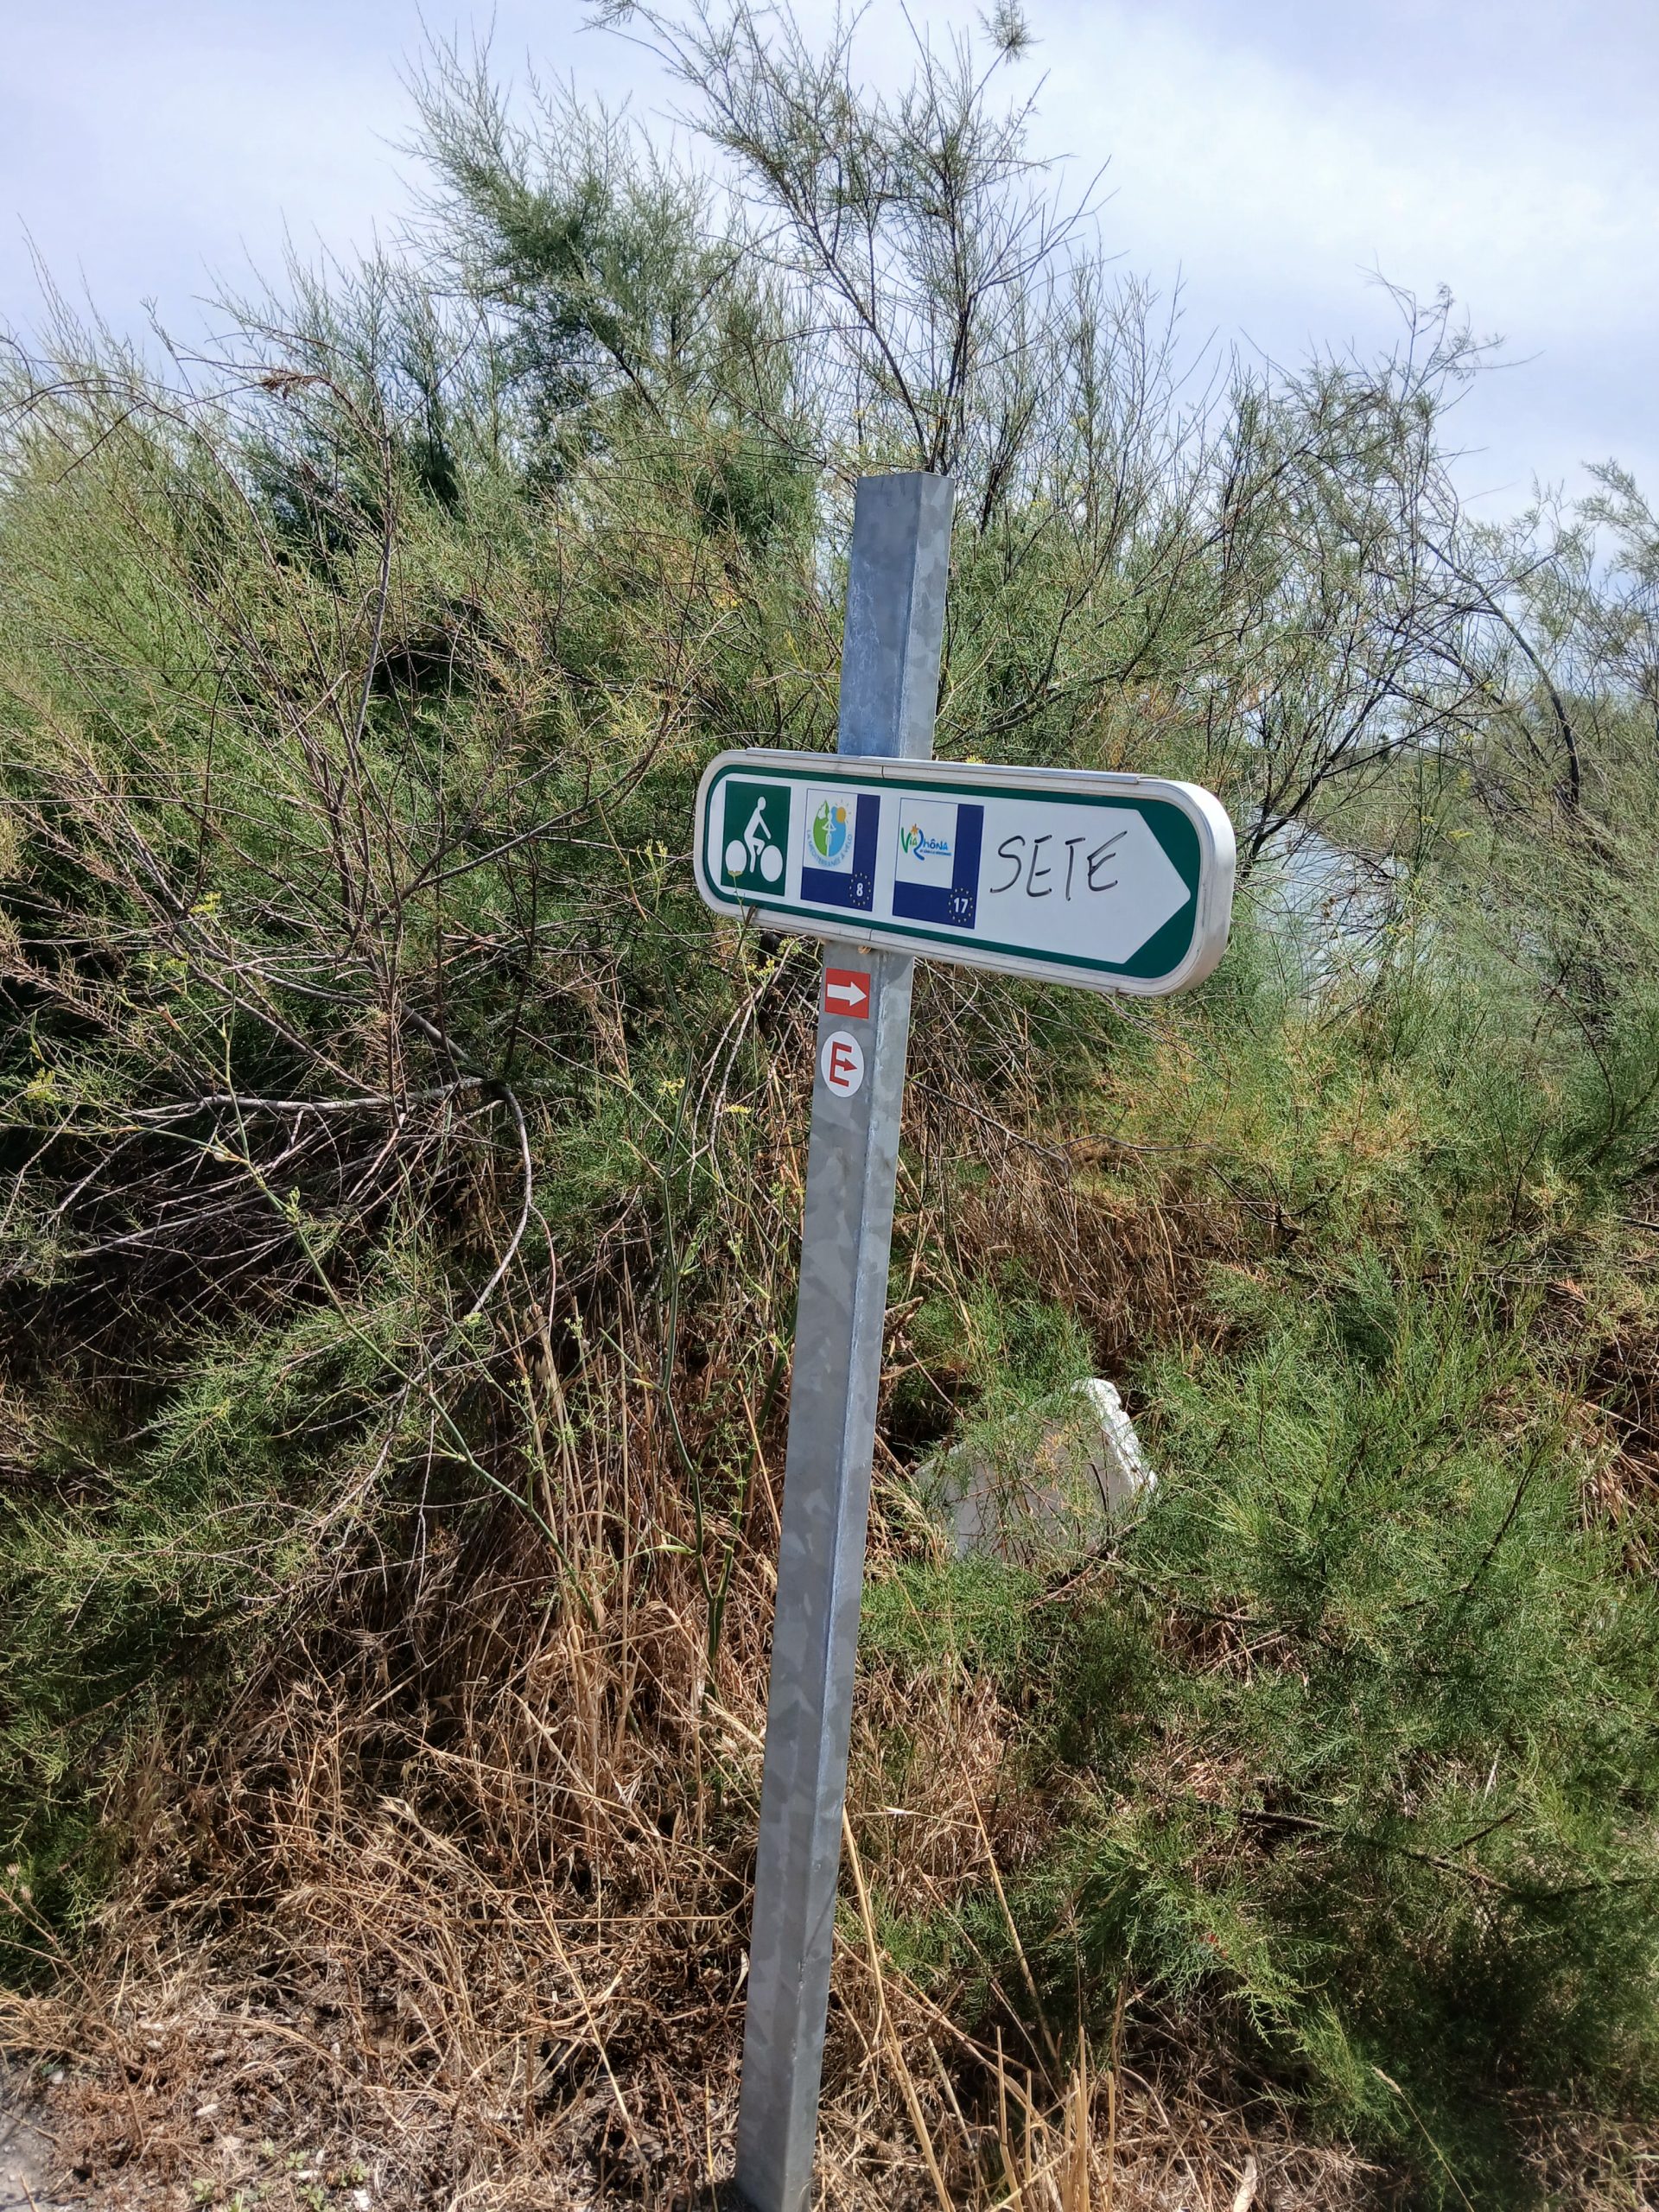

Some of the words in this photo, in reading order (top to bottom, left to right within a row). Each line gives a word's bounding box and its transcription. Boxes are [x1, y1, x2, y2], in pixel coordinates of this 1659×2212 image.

[989, 830, 1128, 901] SETE
[856, 882, 864, 897] 8
[953, 897, 969, 914] 17
